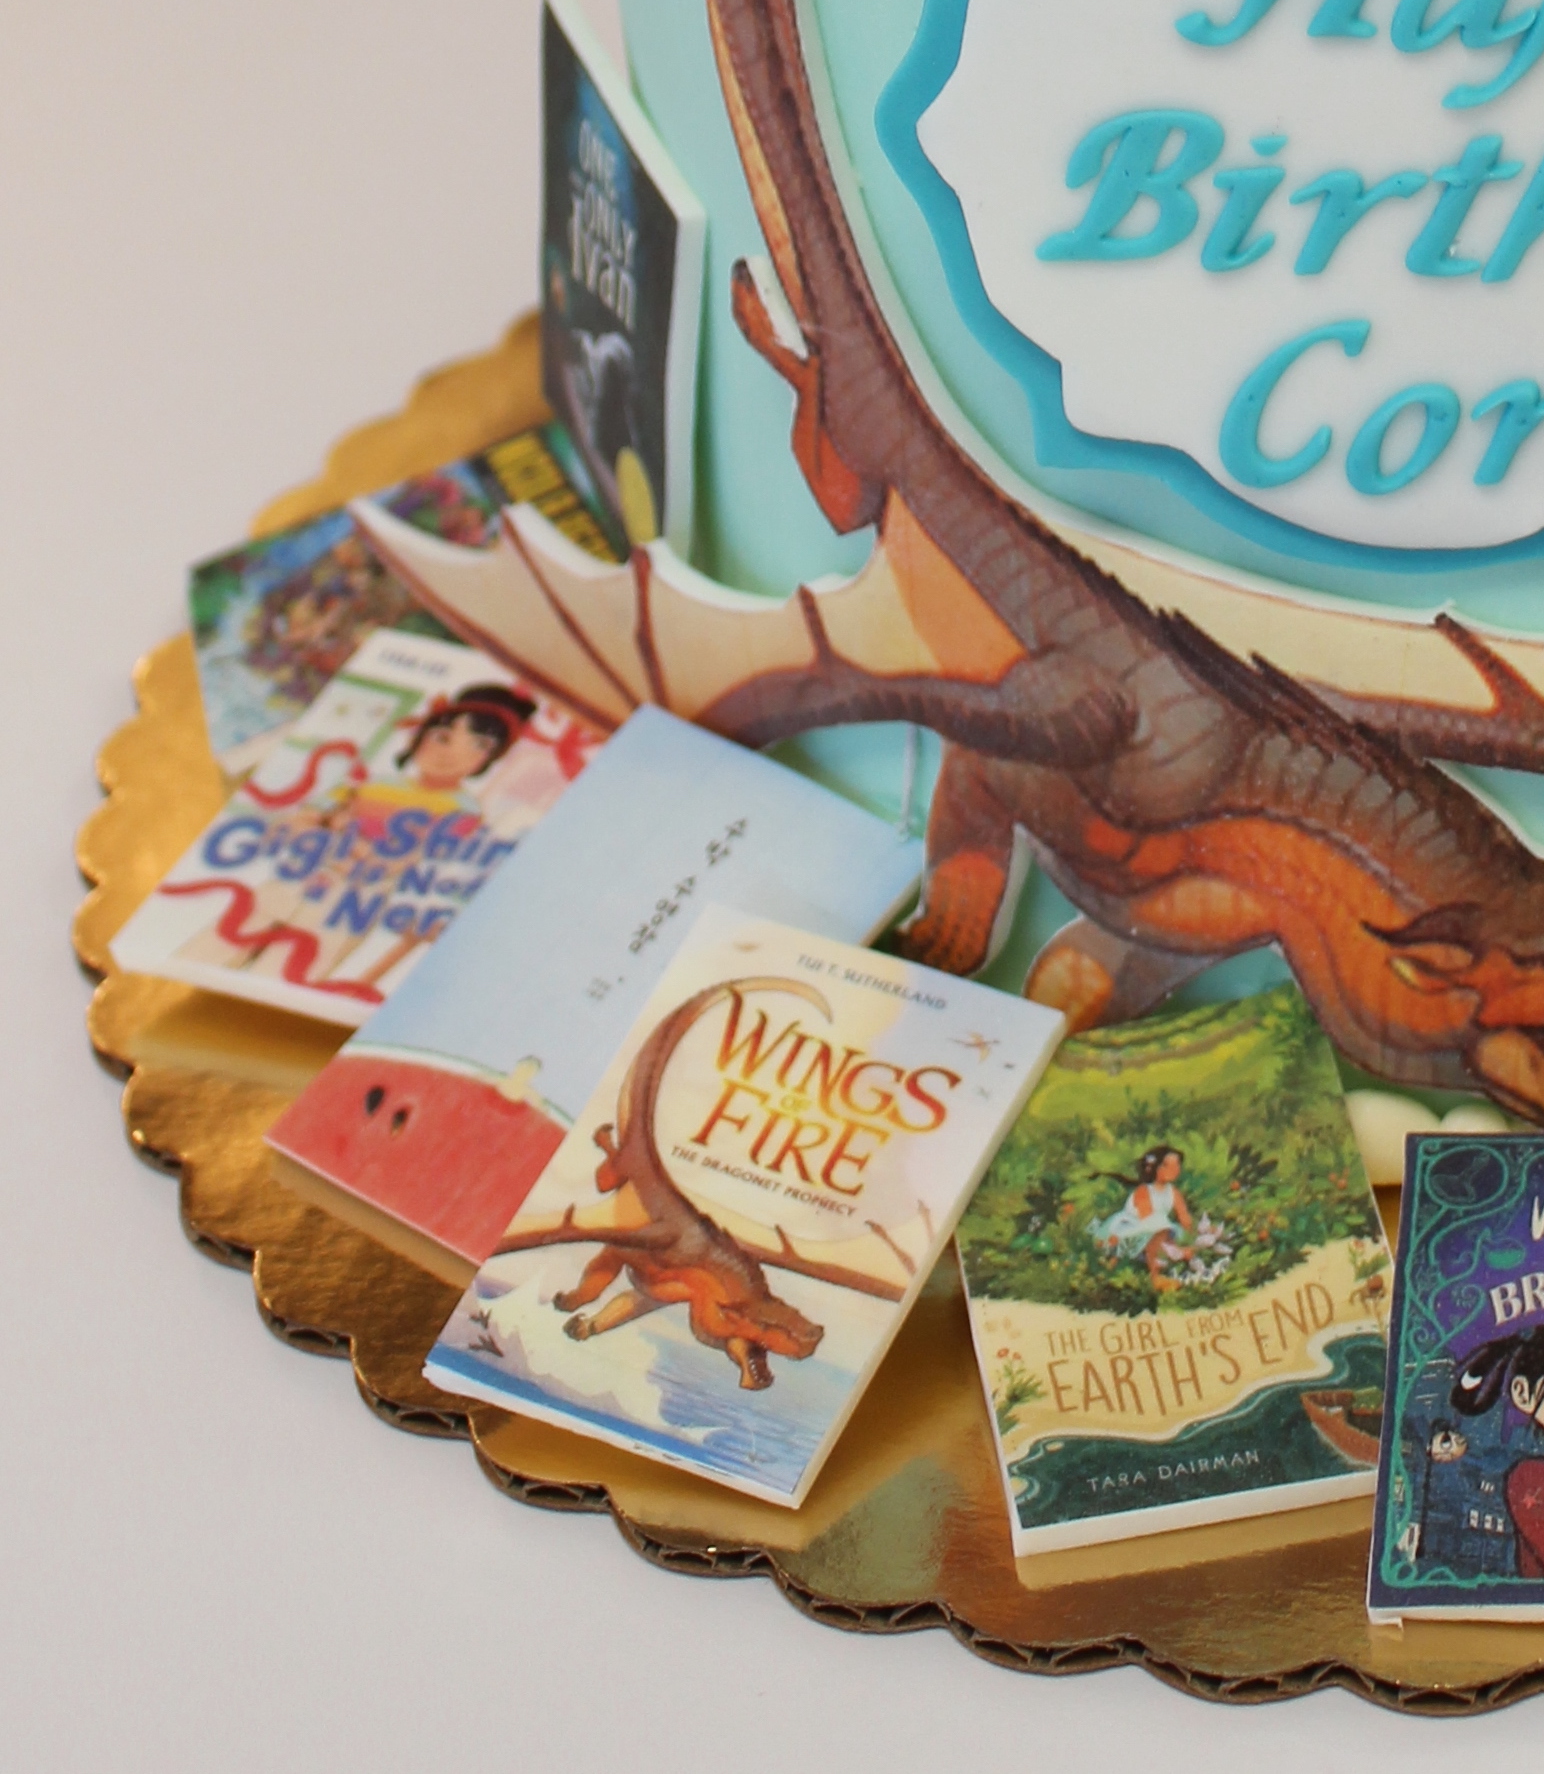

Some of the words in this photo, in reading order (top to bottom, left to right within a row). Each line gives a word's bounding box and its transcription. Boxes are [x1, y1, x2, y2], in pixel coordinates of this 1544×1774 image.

[203, 817, 359, 880] Gigi
[715, 986, 963, 1133] WINGS
[690, 1079, 891, 1197] FIRE
[671, 1145, 698, 1164] THE
[701, 1155, 781, 1192] DRAGONET
[784, 1186, 858, 1217] PROPHECY
[1045, 1329, 1090, 1358] THE
[1099, 1321, 1179, 1356] GIRL
[1186, 1307, 1246, 1338] FROM
[1047, 1334, 1241, 1416] EARTH'S
[1249, 1282, 1335, 1366] END
[1086, 1471, 1147, 1493] TARA
[1158, 1449, 1260, 1481] DAIRMAN
